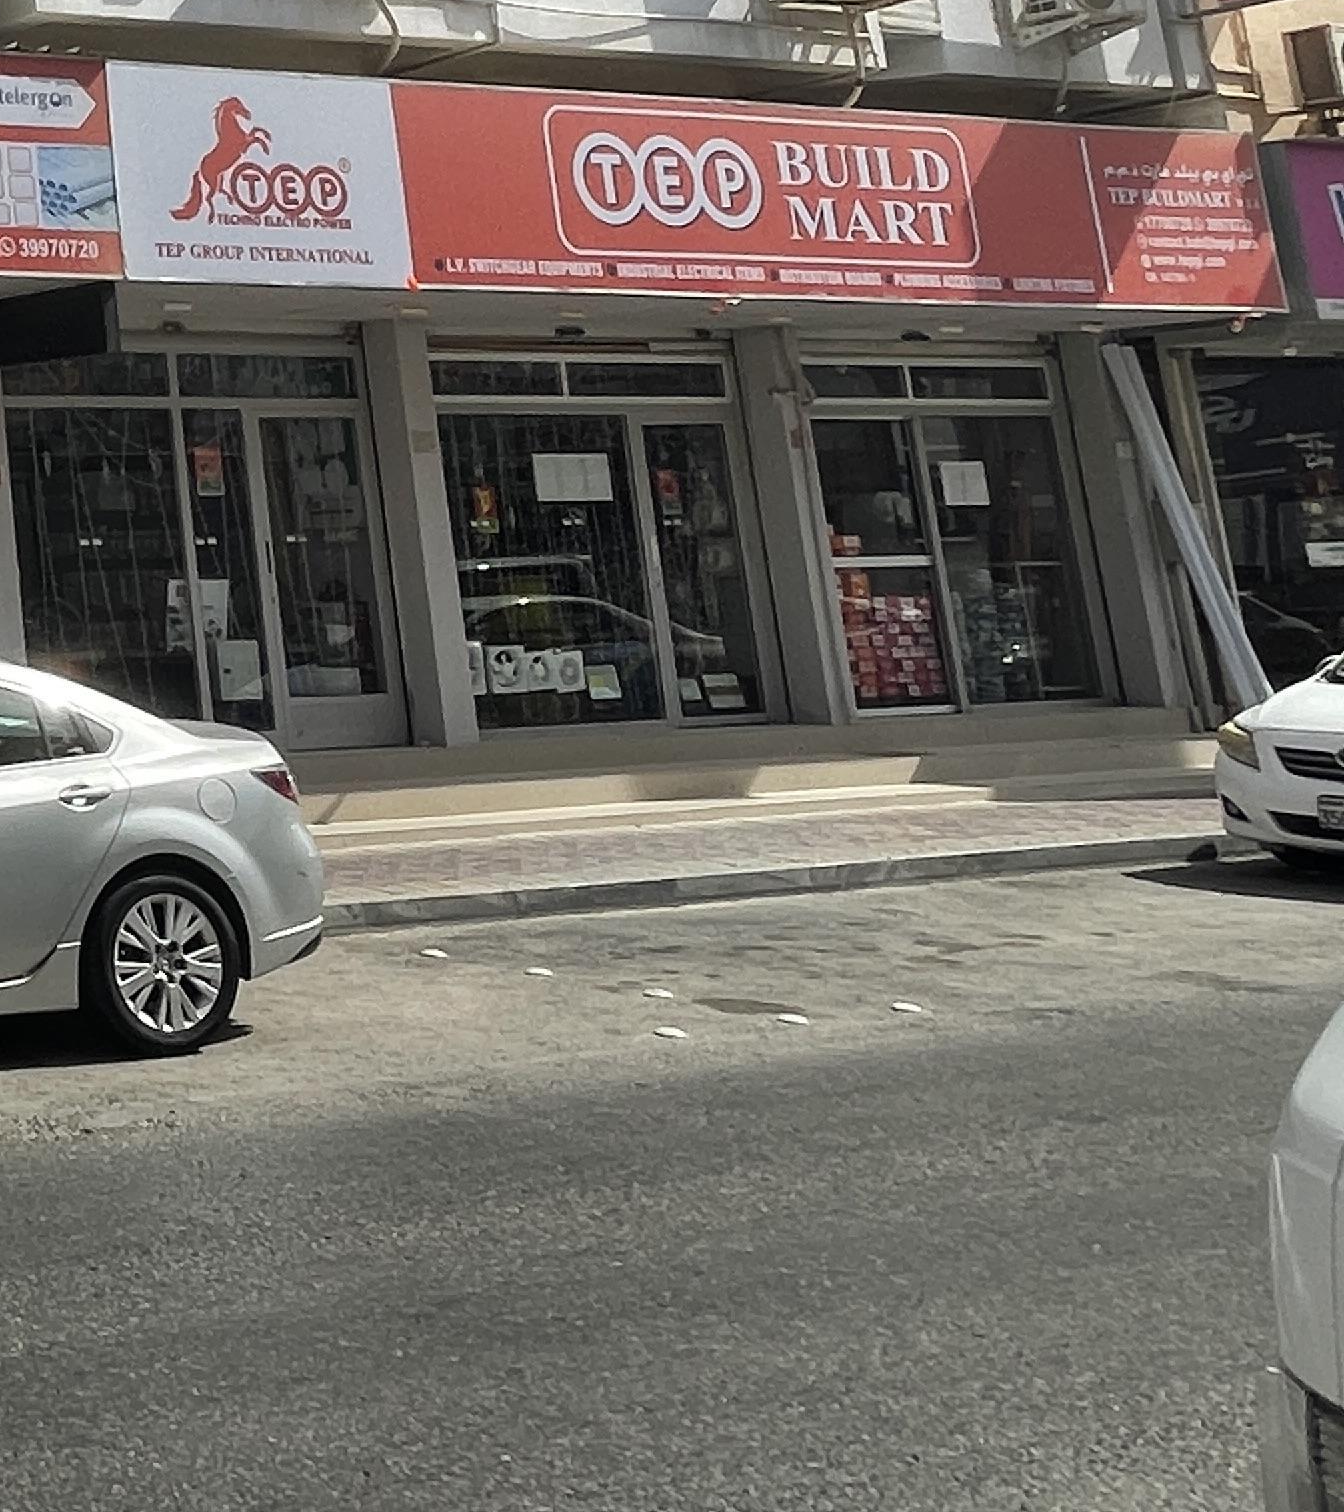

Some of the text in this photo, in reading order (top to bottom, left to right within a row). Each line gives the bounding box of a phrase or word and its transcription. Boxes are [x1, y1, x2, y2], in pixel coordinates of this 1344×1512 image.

[582, 142, 754, 218] TEP
[773, 141, 950, 191] BUILD
[237, 168, 343, 212] TEP
[1107, 186, 1139, 204] TEP
[785, 196, 953, 245] MART
[19, 238, 100, 258] 39970720
[155, 243, 374, 265] TEP GROUP INTERNATIONAL
